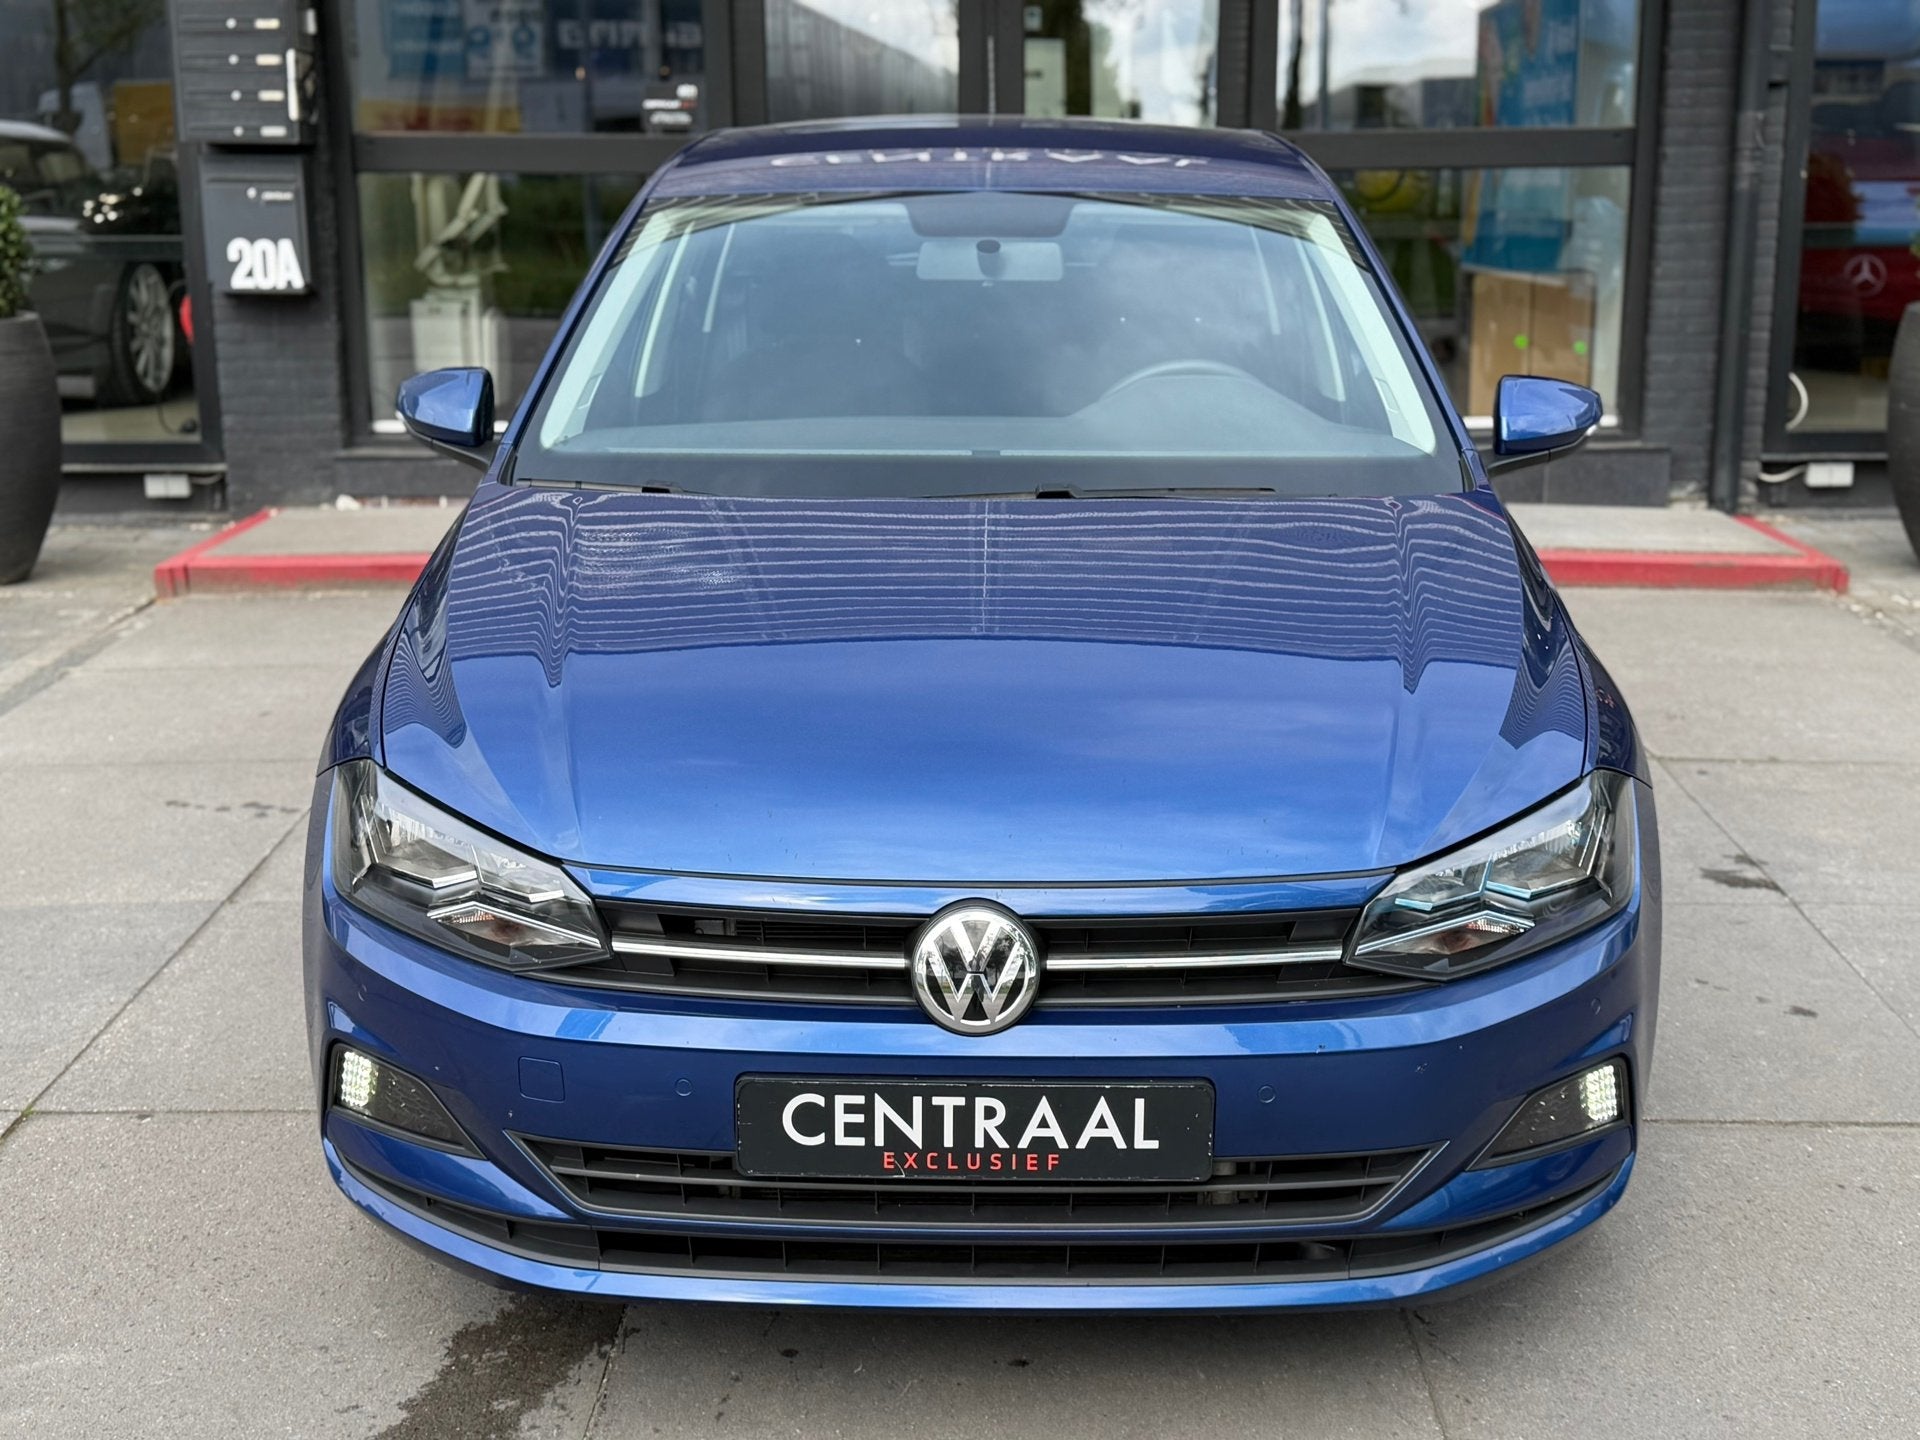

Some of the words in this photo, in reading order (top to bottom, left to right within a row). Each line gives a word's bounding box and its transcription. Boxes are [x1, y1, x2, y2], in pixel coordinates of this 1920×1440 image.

[226, 236, 305, 290] 20A
[914, 908, 1037, 1031] VW
[782, 1092, 1159, 1149] CENTRAAL
[883, 1151, 1060, 1171] EXCLUSIEF
